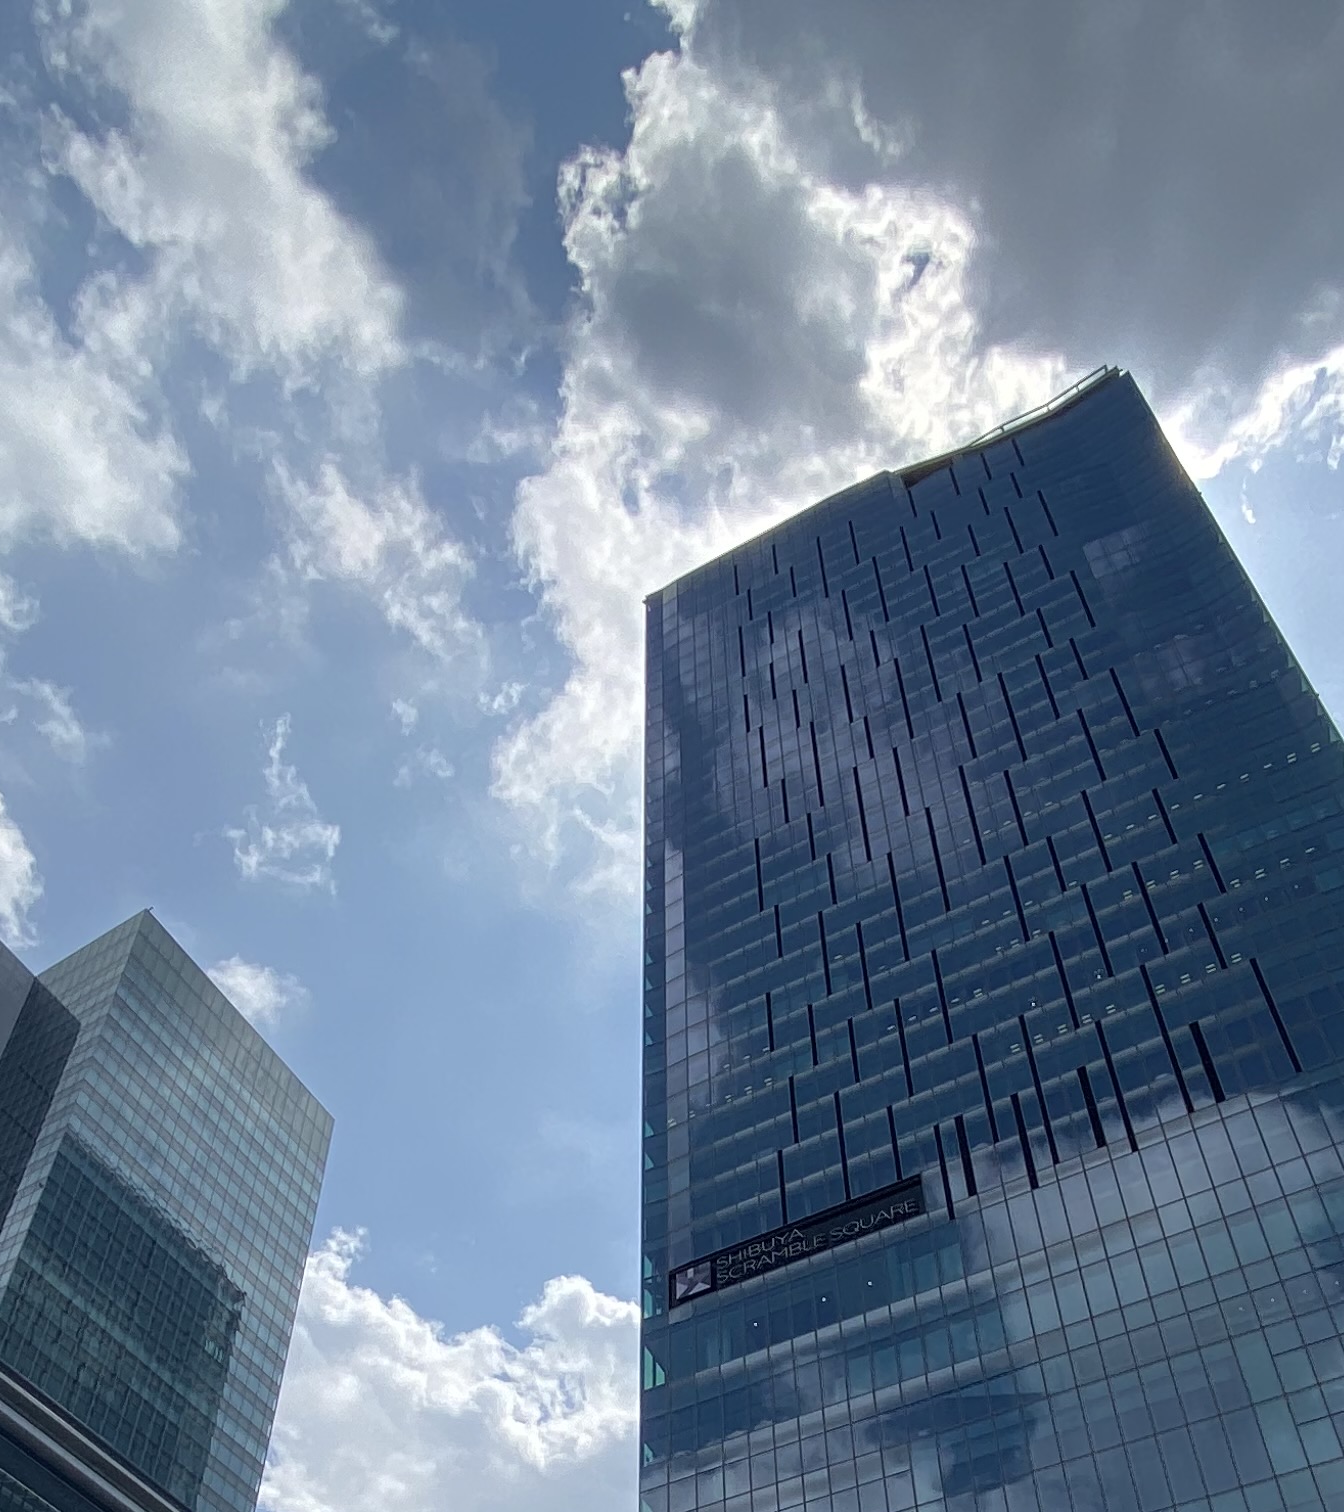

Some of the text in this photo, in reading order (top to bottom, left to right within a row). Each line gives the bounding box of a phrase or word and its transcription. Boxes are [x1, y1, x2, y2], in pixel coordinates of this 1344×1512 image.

[716, 1200, 920, 1283] SCRAMBLE SQUARE
[716, 1229, 804, 1267] SHIBUYA
